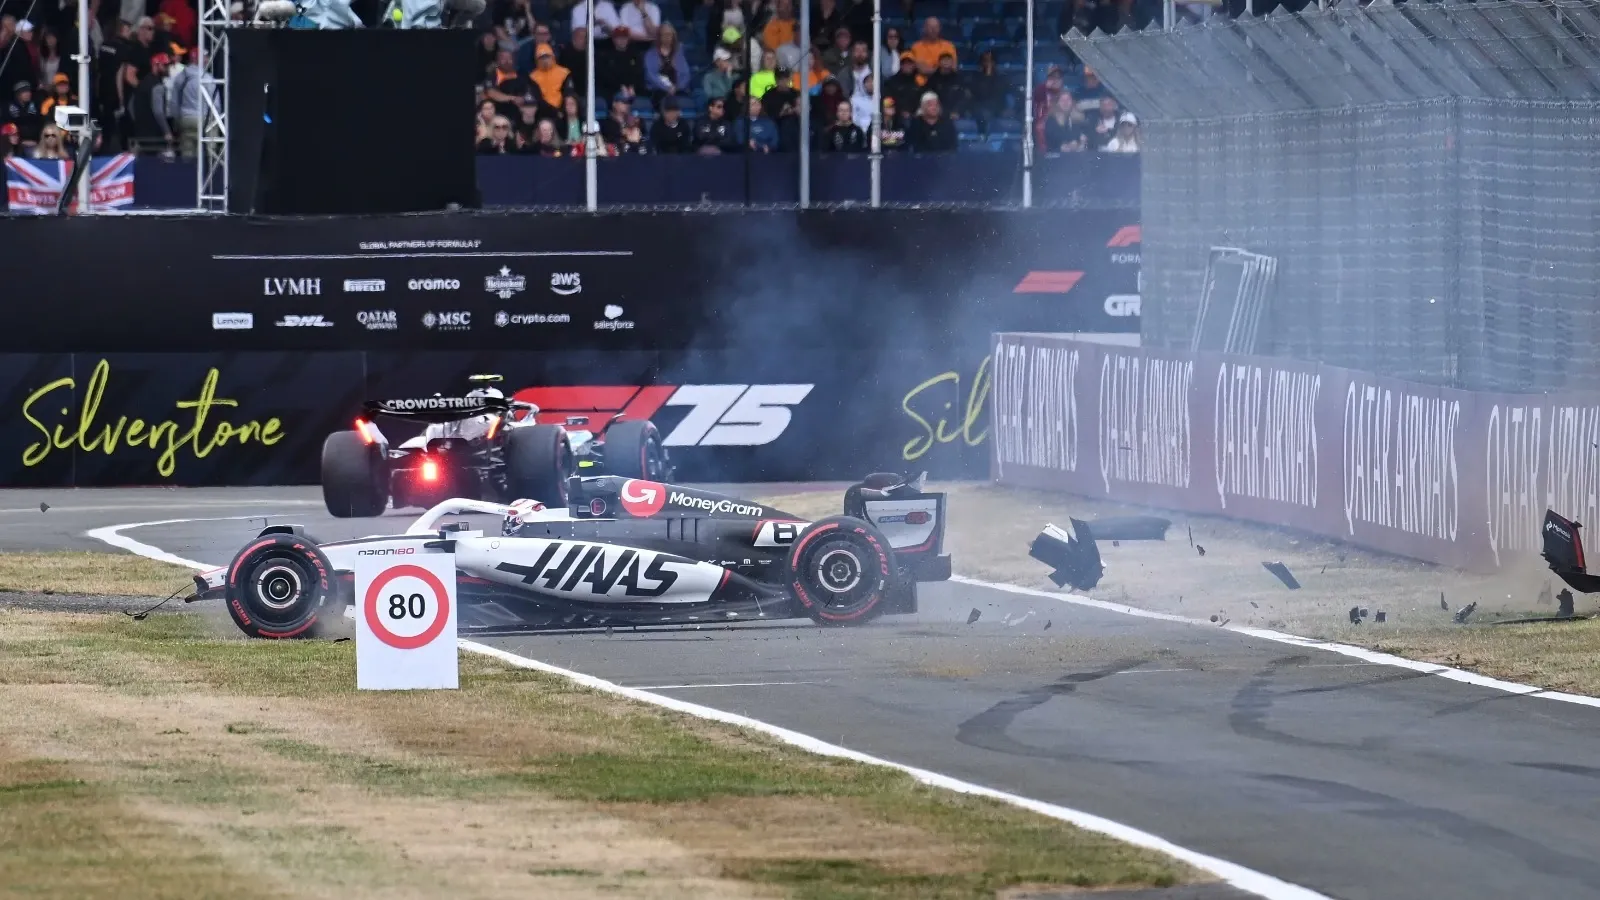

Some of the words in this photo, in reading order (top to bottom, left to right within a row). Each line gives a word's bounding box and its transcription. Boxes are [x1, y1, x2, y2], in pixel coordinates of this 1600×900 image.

[264, 277, 321, 296] LVMH
[407, 278, 460, 291] aramco
[551, 272, 581, 286] aws
[357, 310, 397, 324] QATAR
[438, 312, 471, 325] MSC
[510, 313, 570, 325] crypto.com
[594, 320, 634, 331] salesforce
[386, 397, 486, 410] CROWDSTRIKE
[993, 342, 1026, 478] QATAR
[1027, 346, 1080, 472] AIRWAYS
[22, 358, 285, 477] Silverstone
[1100, 353, 1139, 494] QATAR
[1140, 356, 1193, 488] AIRWAYS
[1215, 362, 1261, 509] QATAR
[1263, 367, 1320, 509] AIRWAYS
[1344, 380, 1391, 535] QATAR
[1395, 392, 1460, 542] AIRWAYS
[1487, 404, 1541, 567] QATAR
[669, 491, 763, 517] MoneyGram
[495, 542, 678, 597] HAAS
[388, 593, 425, 619] 80
